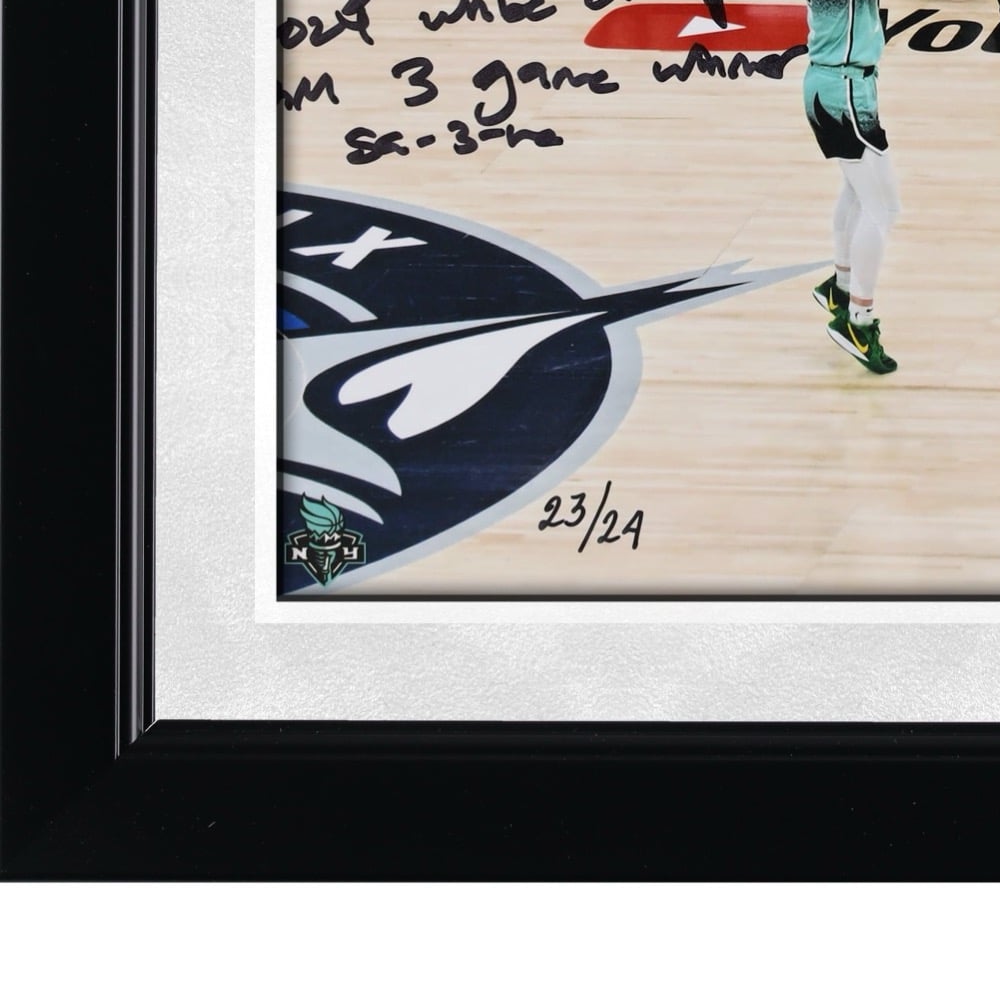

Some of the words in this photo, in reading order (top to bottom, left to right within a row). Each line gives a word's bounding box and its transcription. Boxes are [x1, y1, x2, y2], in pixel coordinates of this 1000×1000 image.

[277, 7, 374, 50] 024
[391, 56, 439, 107] 3
[472, 59, 620, 126] game
[538, 480, 644, 553] 23/24
